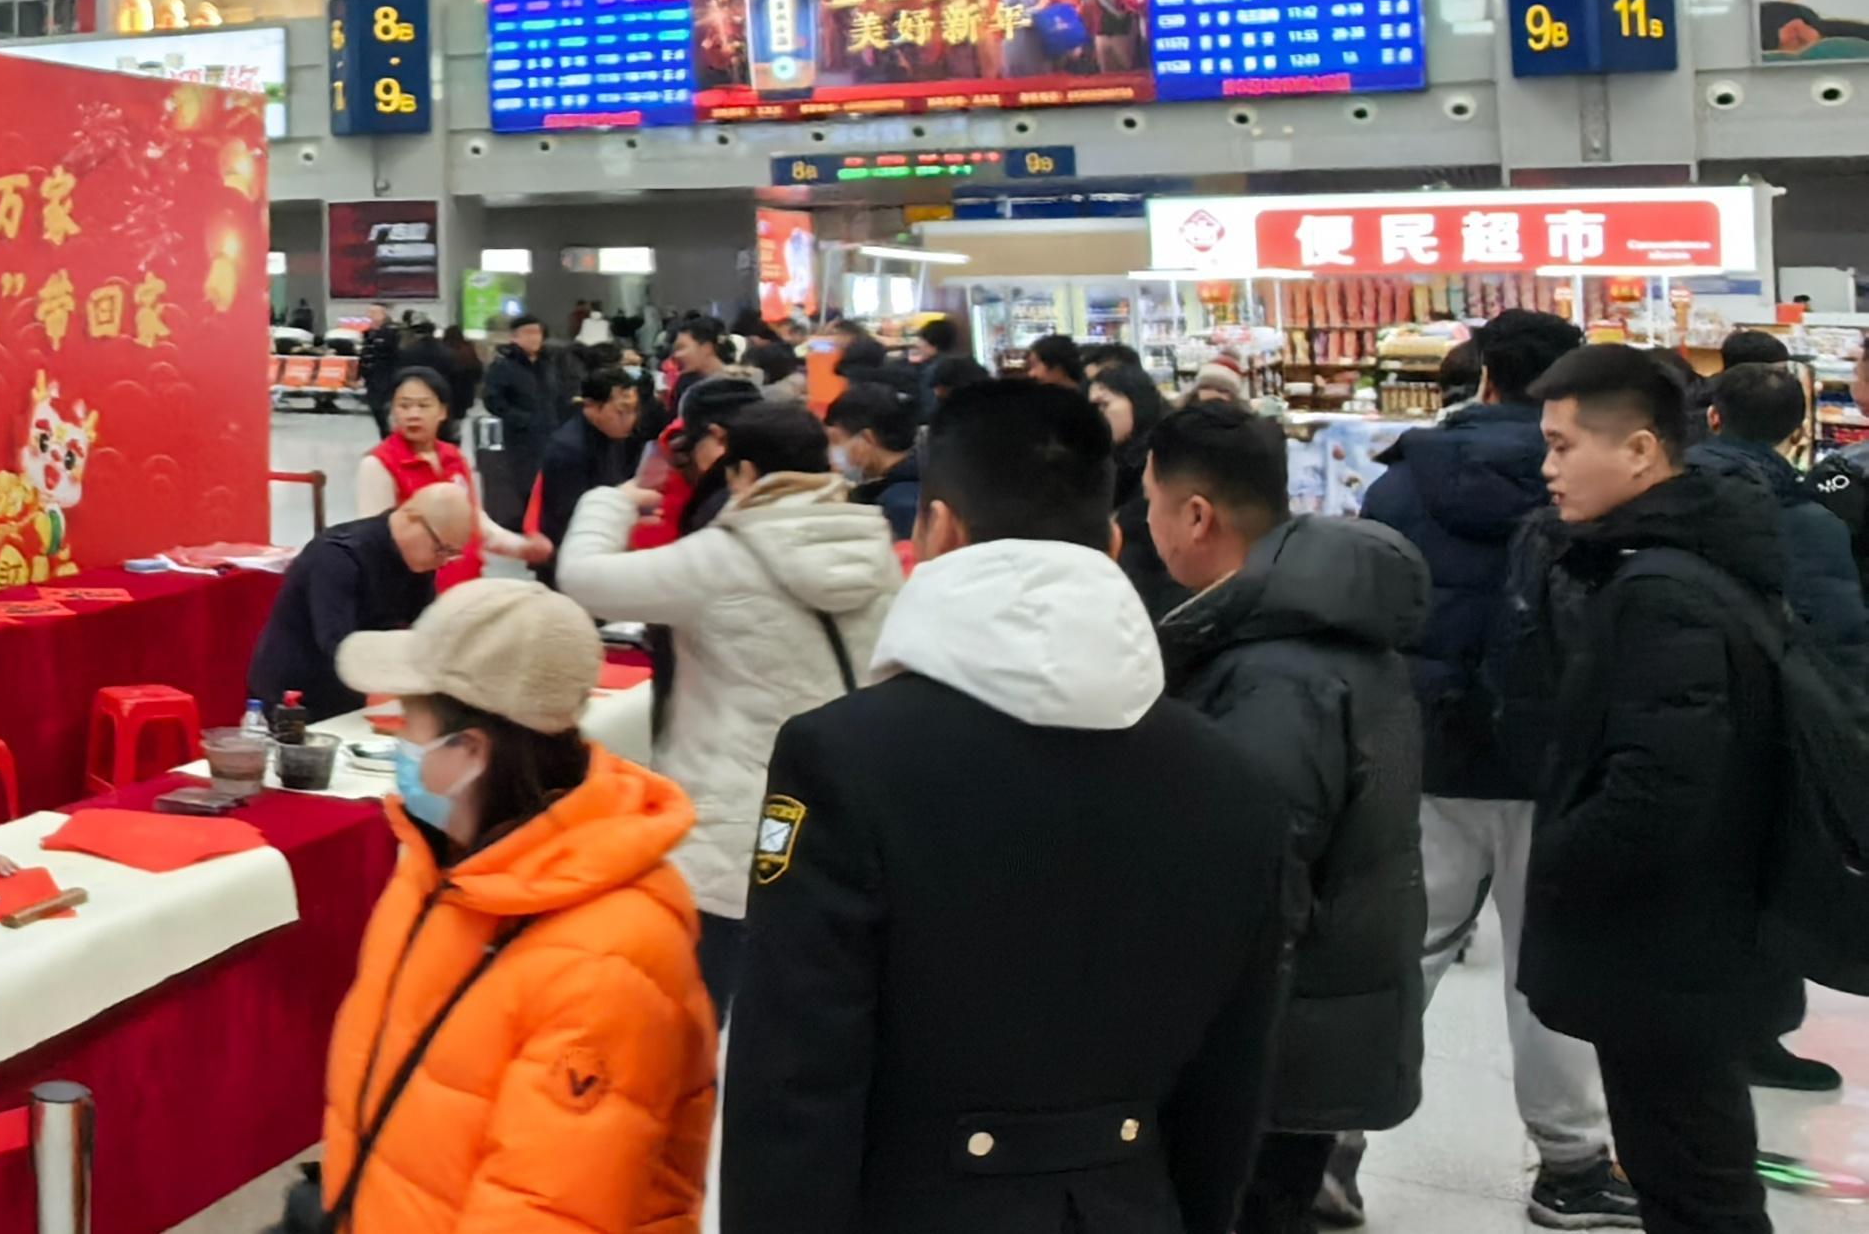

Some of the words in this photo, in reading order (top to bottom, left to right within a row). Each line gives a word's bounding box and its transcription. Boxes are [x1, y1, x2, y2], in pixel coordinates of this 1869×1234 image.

[373, 6, 415, 42] 8B
[847, 2, 1032, 53] 美好新年
[1525, 4, 1569, 51] 9B
[374, 77, 417, 112] 9B
[1295, 210, 1606, 266] 便民超市
